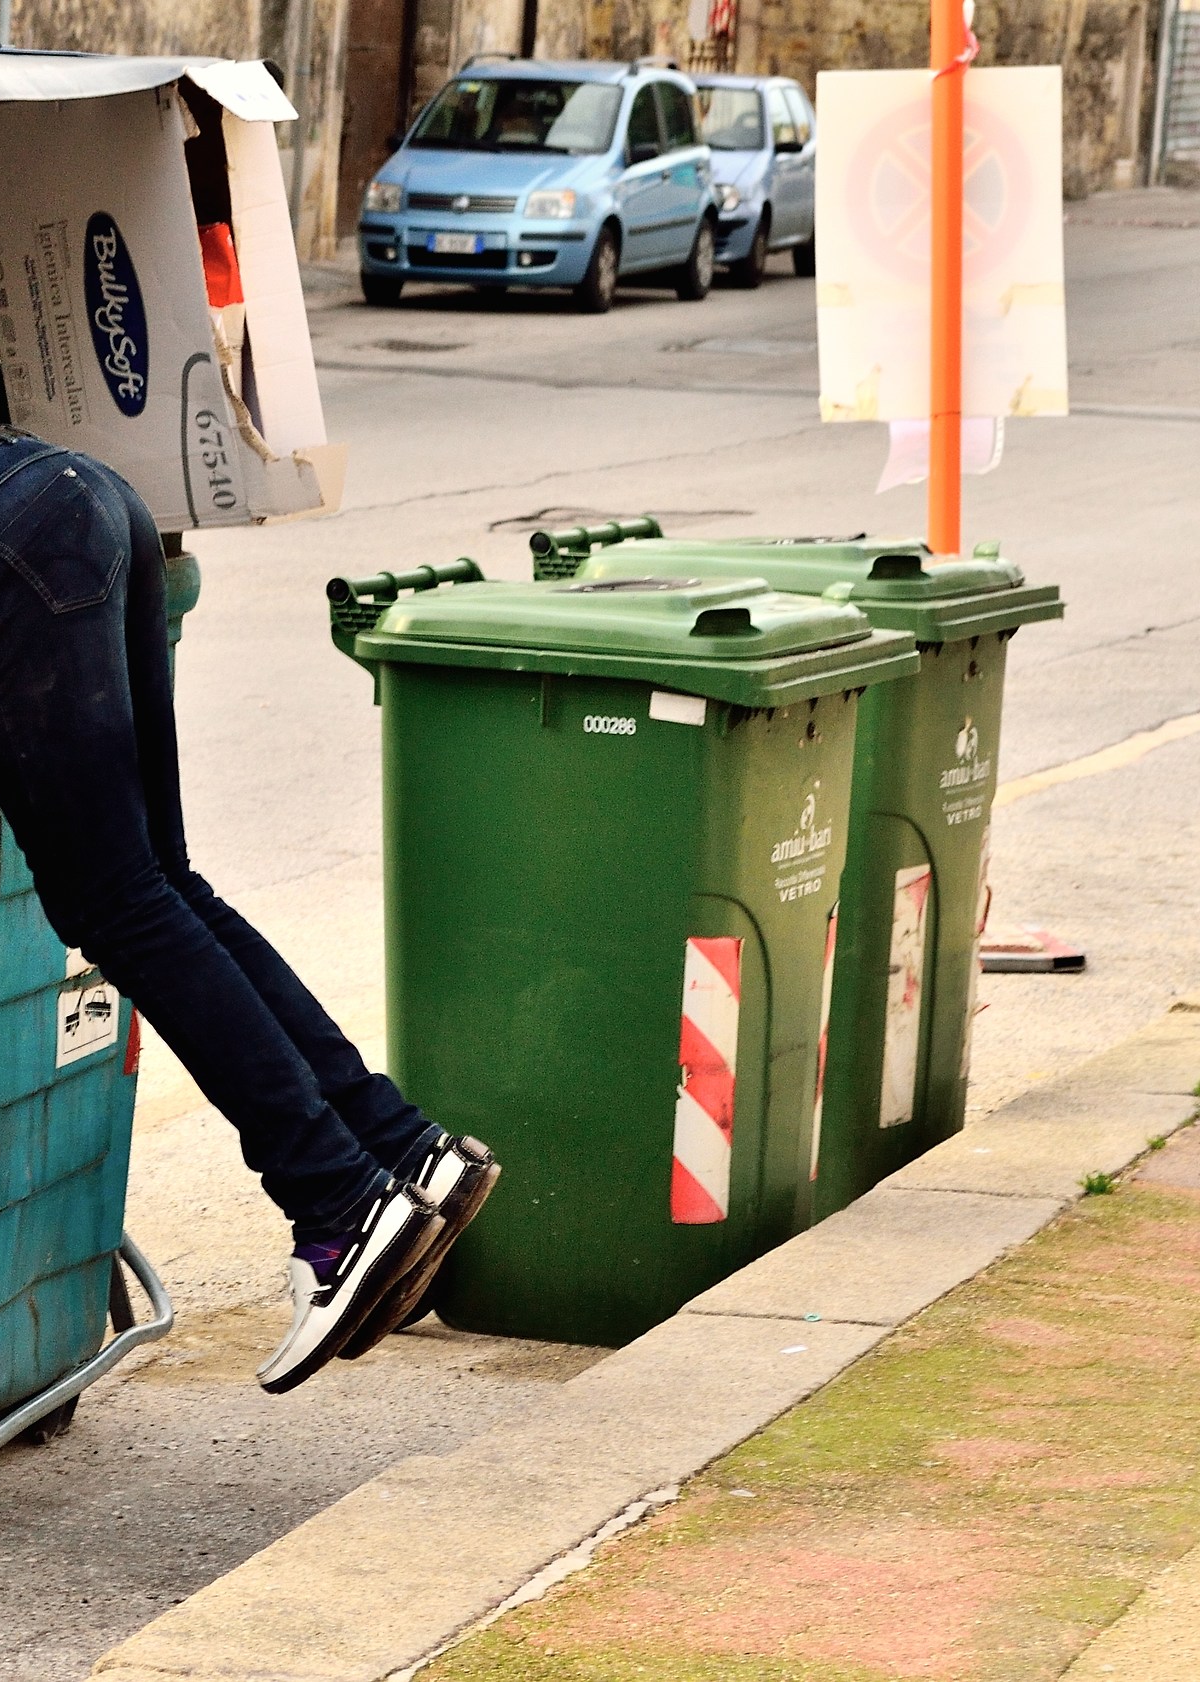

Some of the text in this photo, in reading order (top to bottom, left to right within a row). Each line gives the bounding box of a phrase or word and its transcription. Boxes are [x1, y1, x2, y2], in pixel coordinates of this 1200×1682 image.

[38, 221, 64, 307] Igienica
[194, 407, 238, 511] 67540
[583, 714, 637, 735] 000286
[946, 804, 982, 826] VETRO
[780, 879, 822, 902] VETRO
